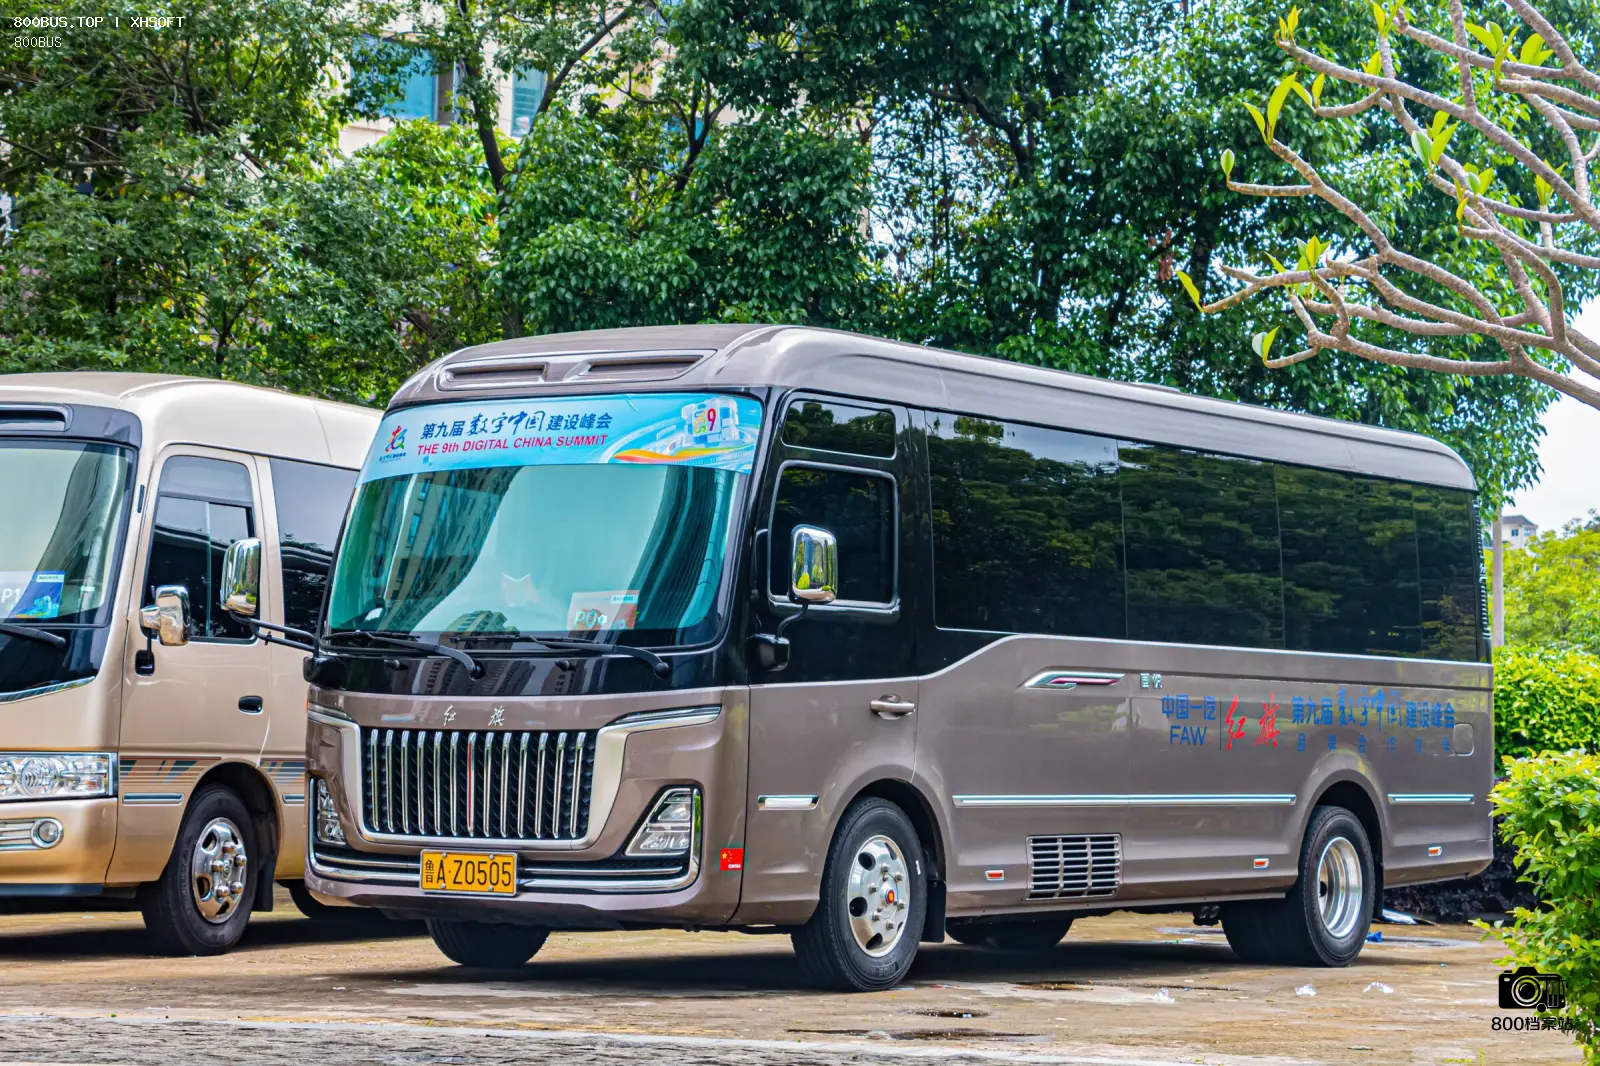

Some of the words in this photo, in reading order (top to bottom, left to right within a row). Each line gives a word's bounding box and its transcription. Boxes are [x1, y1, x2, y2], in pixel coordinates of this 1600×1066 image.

[420, 411, 612, 439] 第九届数字中国建设峰会
[417, 444, 440, 456] THE
[441, 442, 459, 454] 9th
[462, 438, 509, 452] DIGITAL
[513, 436, 552, 449] CHINA
[556, 434, 609, 447] SUMMIT
[1161, 694, 1216, 721] 中国一汽
[1169, 725, 1208, 746] FAW
